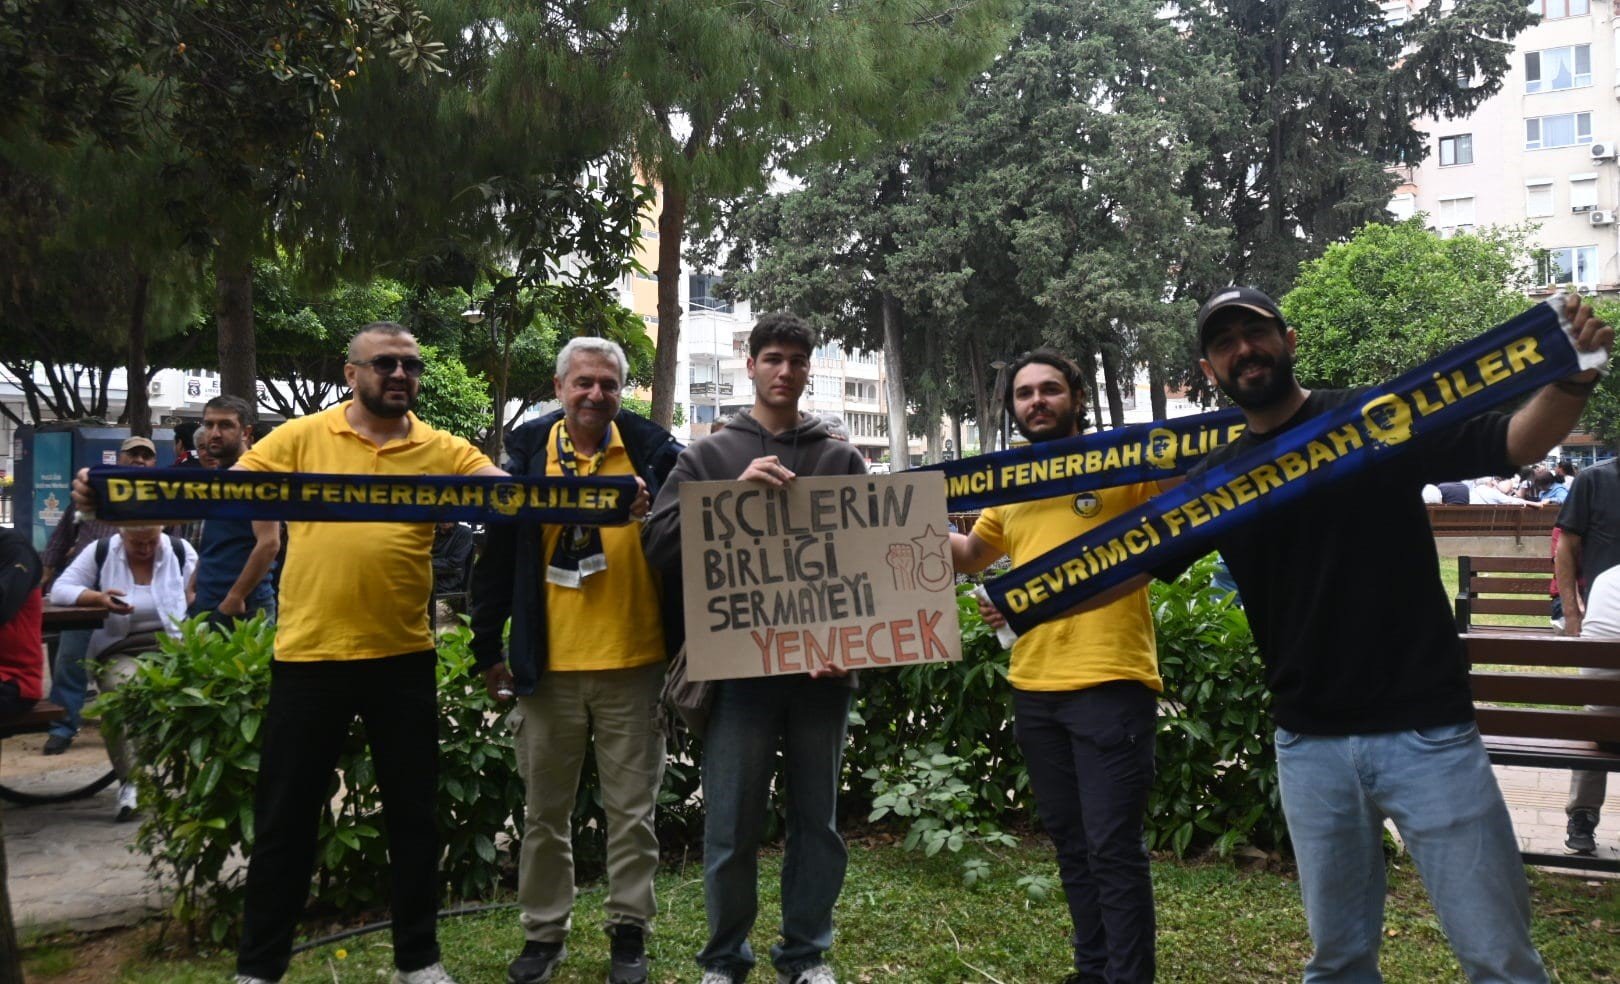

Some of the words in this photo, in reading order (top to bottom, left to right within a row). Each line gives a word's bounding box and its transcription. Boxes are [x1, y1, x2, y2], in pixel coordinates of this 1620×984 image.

[107, 477, 290, 502] DEVRİMCİ
[301, 483, 484, 506] FENERBAH
[1001, 441, 1142, 489] FENERBAH
[1004, 516, 1160, 615] DEVRİMCİ
[1161, 423, 1364, 538] FENERBAH
[1411, 336, 1544, 417] LİLER
[707, 572, 875, 632] SERMAYEYİ
[751, 609, 950, 674] YENECEK
